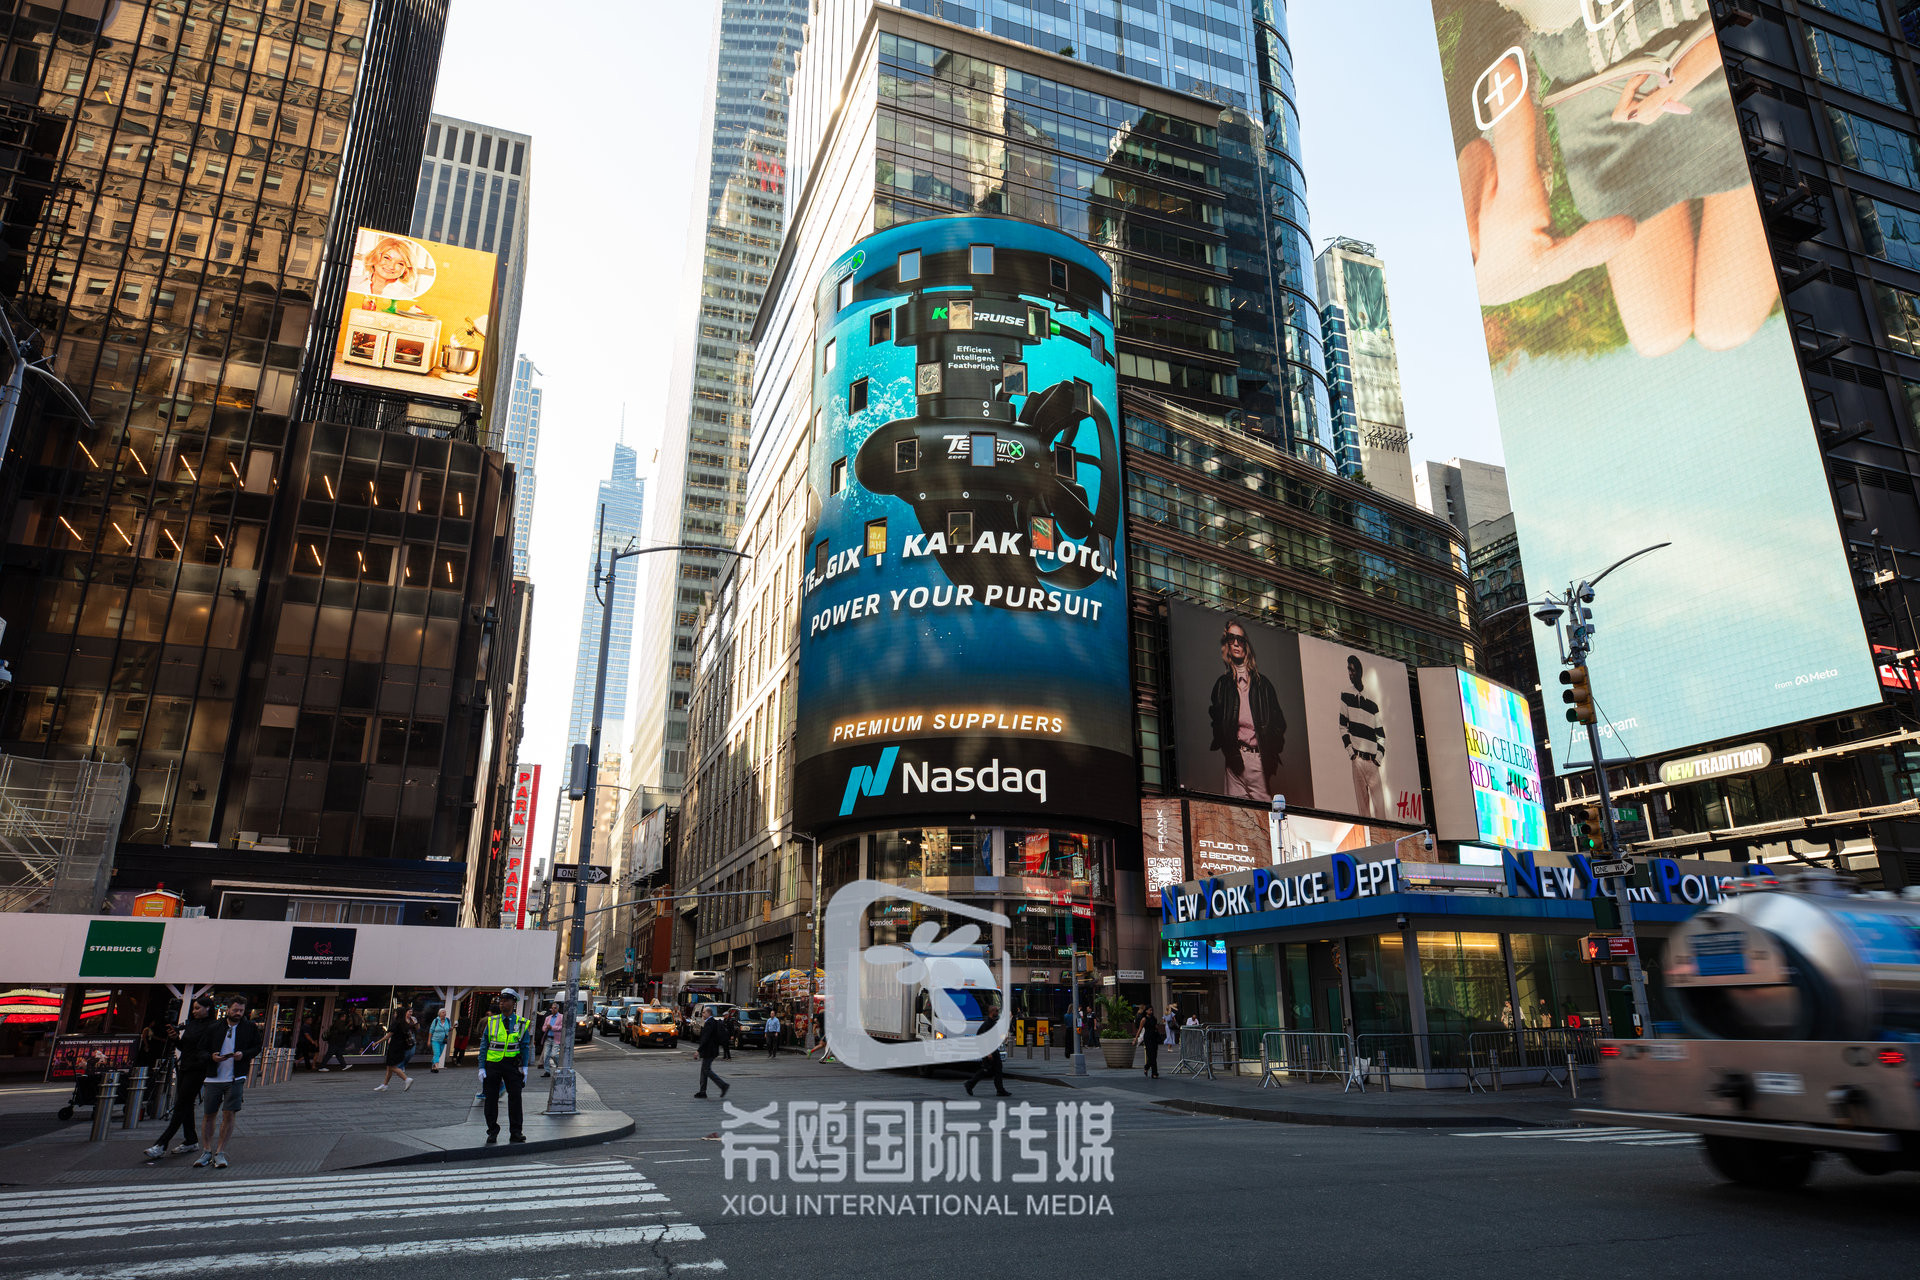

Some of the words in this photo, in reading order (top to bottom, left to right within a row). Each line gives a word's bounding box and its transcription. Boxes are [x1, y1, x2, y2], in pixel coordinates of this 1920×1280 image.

[948, 363, 1000, 371] Featherlight
[953, 354, 996, 362] Intelligent
[902, 531, 1023, 558] KAAK
[810, 593, 881, 637] POWER
[890, 584, 974, 611] YOUR
[984, 585, 1102, 621] PURSUIT
[1774, 681, 1793, 690] from
[1809, 668, 1839, 682] Meta
[832, 715, 923, 742] PREMIUM
[933, 713, 1063, 733] SUPPLIERS
[902, 758, 1047, 803] Nasdaq
[513, 772, 531, 825] PARK
[1396, 790, 1422, 822] H&M
[1156, 809, 1165, 852] FRANK
[1199, 840, 1234, 851] STUDIO
[1235, 844, 1249, 852] TO
[1209, 852, 1256, 863] BEDROOM
[561, 869, 578, 878] ONE
[1501, 848, 1576, 898] NEW
[1595, 864, 1609, 873] ONE
[1614, 863, 1629, 872] WAY
[503, 858, 521, 912] PARK
[1161, 885, 1199, 925] NEW
[1199, 877, 1251, 919] YORK
[1253, 868, 1325, 912] POLICE
[1331, 853, 1399, 901] DEPT
[1026, 906, 1047, 914] Nasdaq
